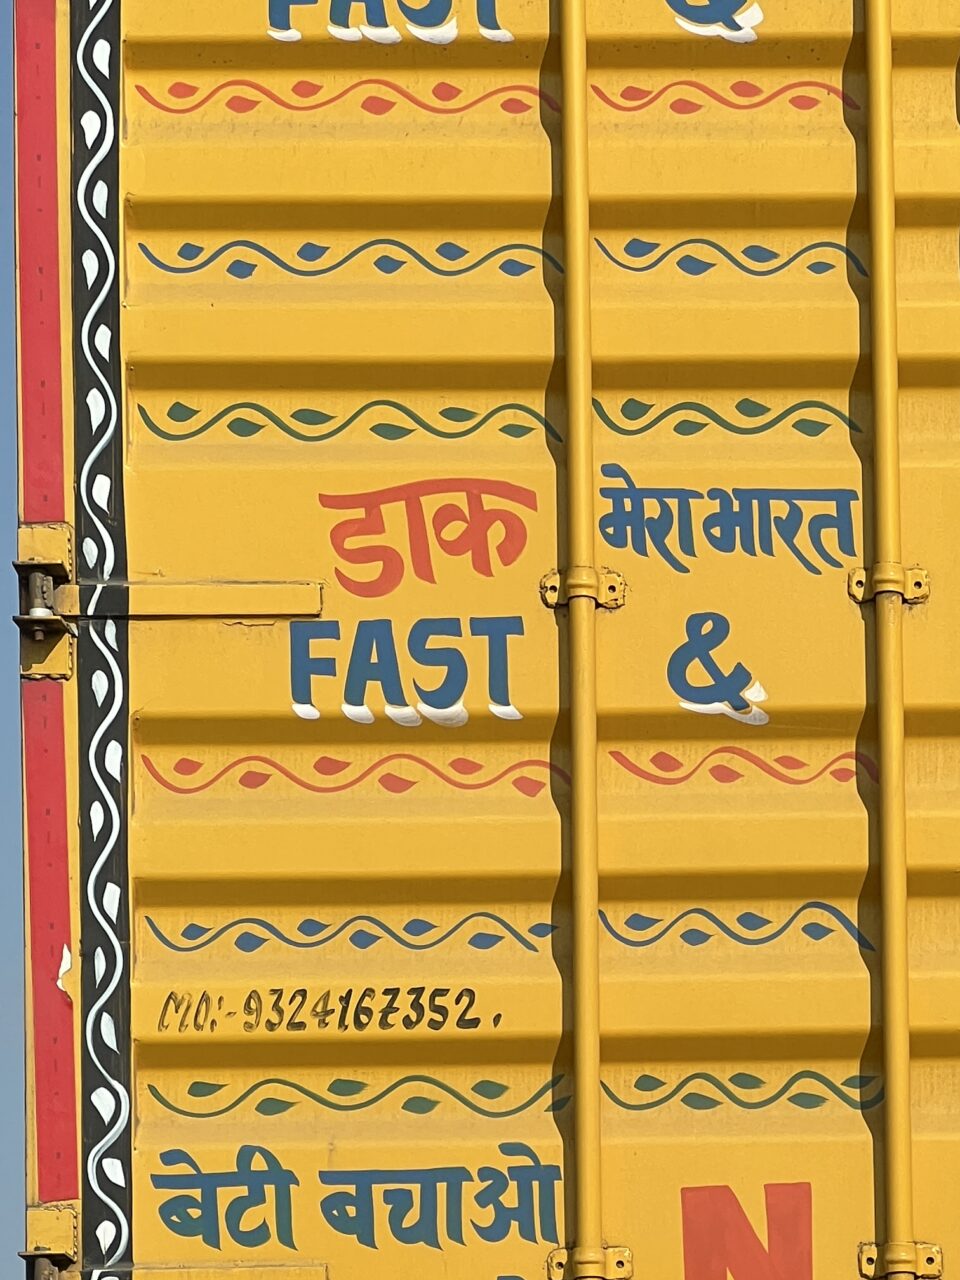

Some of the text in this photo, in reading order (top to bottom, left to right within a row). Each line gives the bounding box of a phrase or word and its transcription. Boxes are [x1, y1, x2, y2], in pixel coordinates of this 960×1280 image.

[318, 477, 538, 598] डाक
[702, 486, 859, 575] भारत
[289, 615, 525, 713] FAST
[667, 612, 758, 715] &
[150, 1142, 564, 1251] बेटी बचाओ
